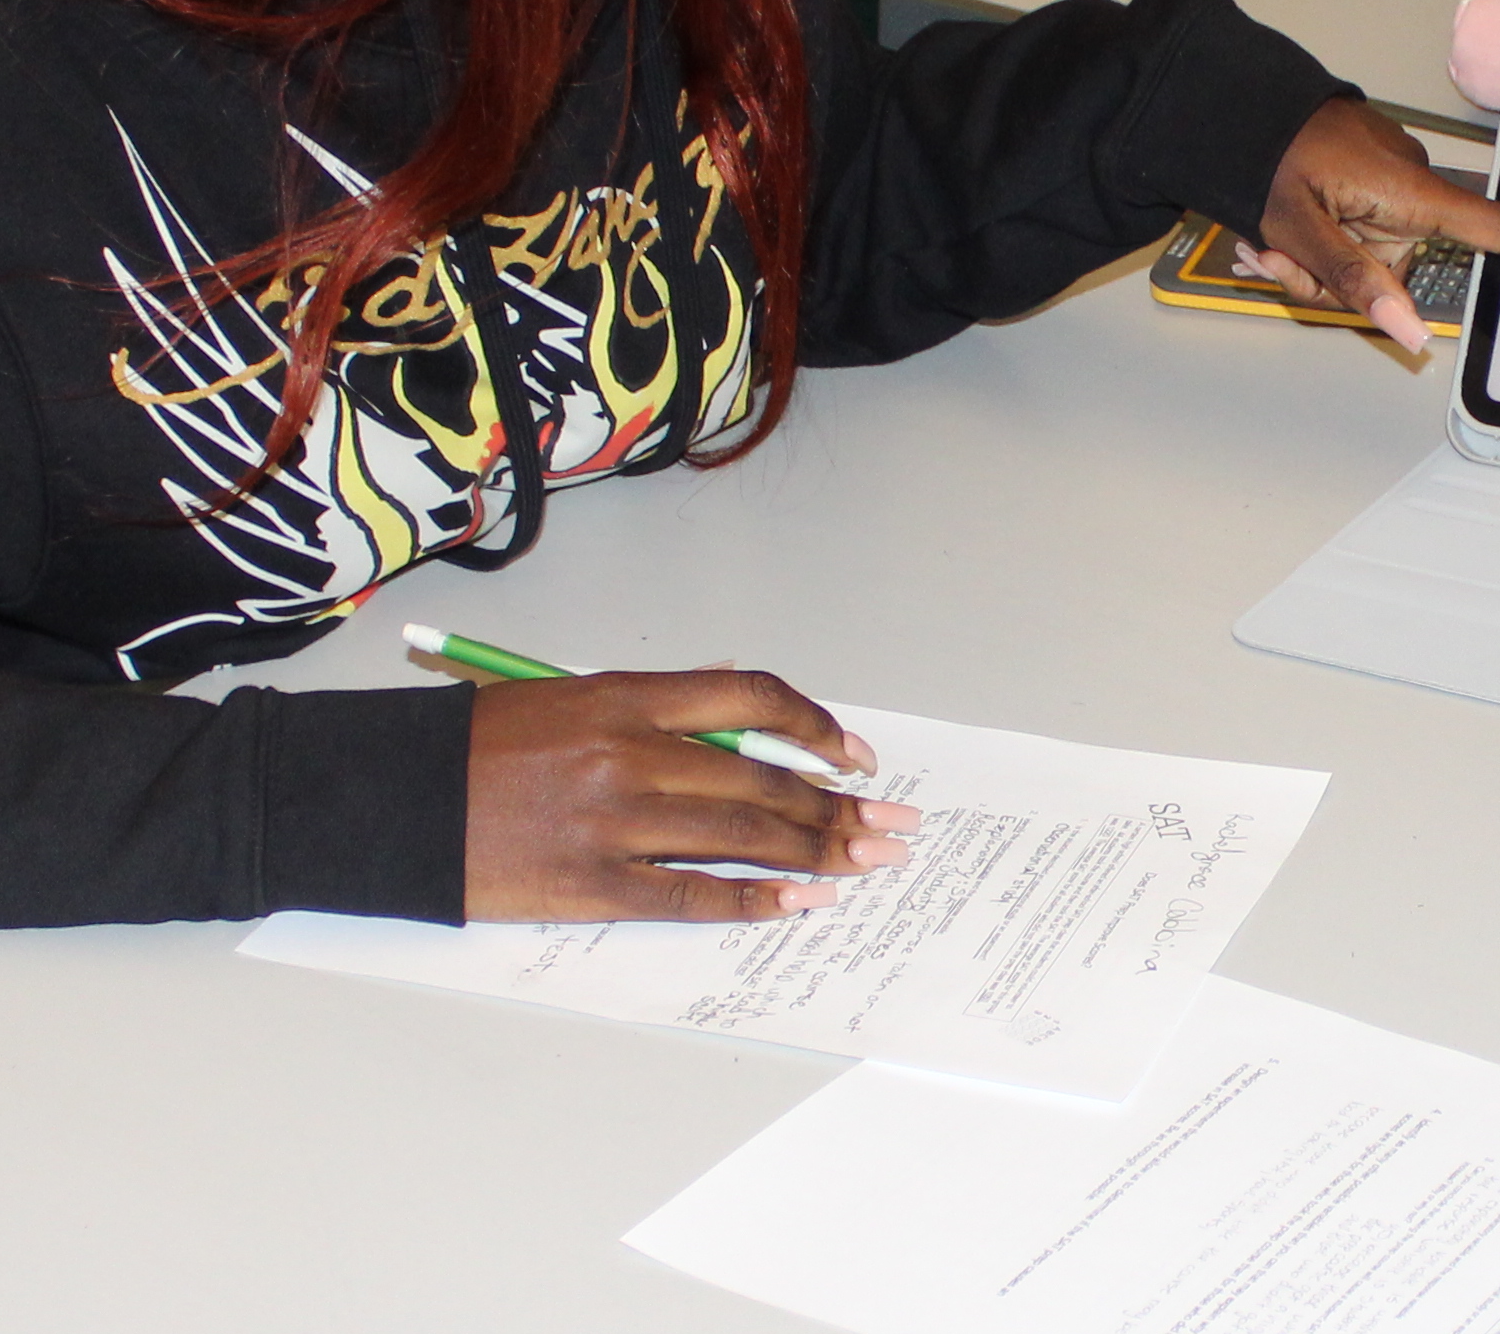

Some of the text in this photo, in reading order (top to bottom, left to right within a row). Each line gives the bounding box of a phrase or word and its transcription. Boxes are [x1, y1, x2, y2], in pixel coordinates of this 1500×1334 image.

[1147, 801, 1193, 842] SAT
[829, 893, 858, 919] more
[858, 894, 886, 918] who
[937, 885, 966, 915] SAT
[1080, 871, 1158, 969] Does SAT Prep Improve Scores?
[839, 921, 870, 947] took
[869, 917, 912, 960] scores
[900, 912, 936, 954] course
[821, 949, 850, 965] the
[874, 960, 910, 992] taken
[788, 970, 828, 1010] course
[718, 990, 767, 1029] lead to
[745, 986, 783, 1019] which
[864, 993, 879, 1010] or
[843, 1011, 864, 1033] not
[1220, 1062, 1250, 1087] increase
[1239, 1066, 1269, 1089] Design
[1211, 1085, 1223, 1093] in
[1232, 1087, 1242, 1096] an
[1200, 1091, 1219, 1106] SAT
[1193, 1095, 1233, 1128] experiment
[1163, 1123, 1181, 1134] Be
[1388, 1112, 1413, 1132] scores
[1400, 1117, 1431, 1140] Identify
[1154, 1132, 1167, 1141] as
[1178, 1127, 1198, 1141] that
[1377, 1130, 1393, 1143] are
[1393, 1138, 1406, 1148] as
[1124, 1140, 1160, 1167] thorough
[1157, 1138, 1182, 1159] would
[1358, 1141, 1384, 1162] higher
[1374, 1146, 1398, 1164] many
[1114, 1165, 1127, 1175] as
[1139, 1156, 1161, 1174] allow
[1347, 1159, 1364, 1171] for
[1359, 1162, 1380, 1181] other
[1120, 1180, 1135, 1189] to
[1128, 1171, 1141, 1182] us
[1328, 1169, 1352, 1187] those
[1313, 1185, 1332, 1200] who
[1331, 1178, 1362, 1205] possible
[1084, 1187, 1124, 1220] determine
[1298, 1199, 1319, 1215] took
[1285, 1213, 1303, 1226] the
[1302, 1204, 1334, 1232] variables
[1065, 1224, 1084, 1237] the
[1268, 1223, 1290, 1242] prep
[1287, 1231, 1308, 1246] that
[1051, 1235, 1072, 1252] SAT
[1246, 1240, 1273, 1263] course
[1273, 1242, 1292, 1257] you
[1031, 1247, 1054, 1266] prep
[1261, 1256, 1278, 1270] can
[1006, 1264, 1035, 1287] causes
[1230, 1261, 1251, 1277] than
[1246, 1268, 1267, 1283] that
[1219, 1276, 1237, 1288] for
[1229, 1281, 1251, 1297] may
[996, 1286, 1010, 1297] an
[1198, 1286, 1224, 1306] those
[1182, 1304, 1202, 1321] who
[1207, 1295, 1235, 1321] explain
[1168, 1319, 1186, 1334] did
[1188, 1320, 1209, 1334] why
